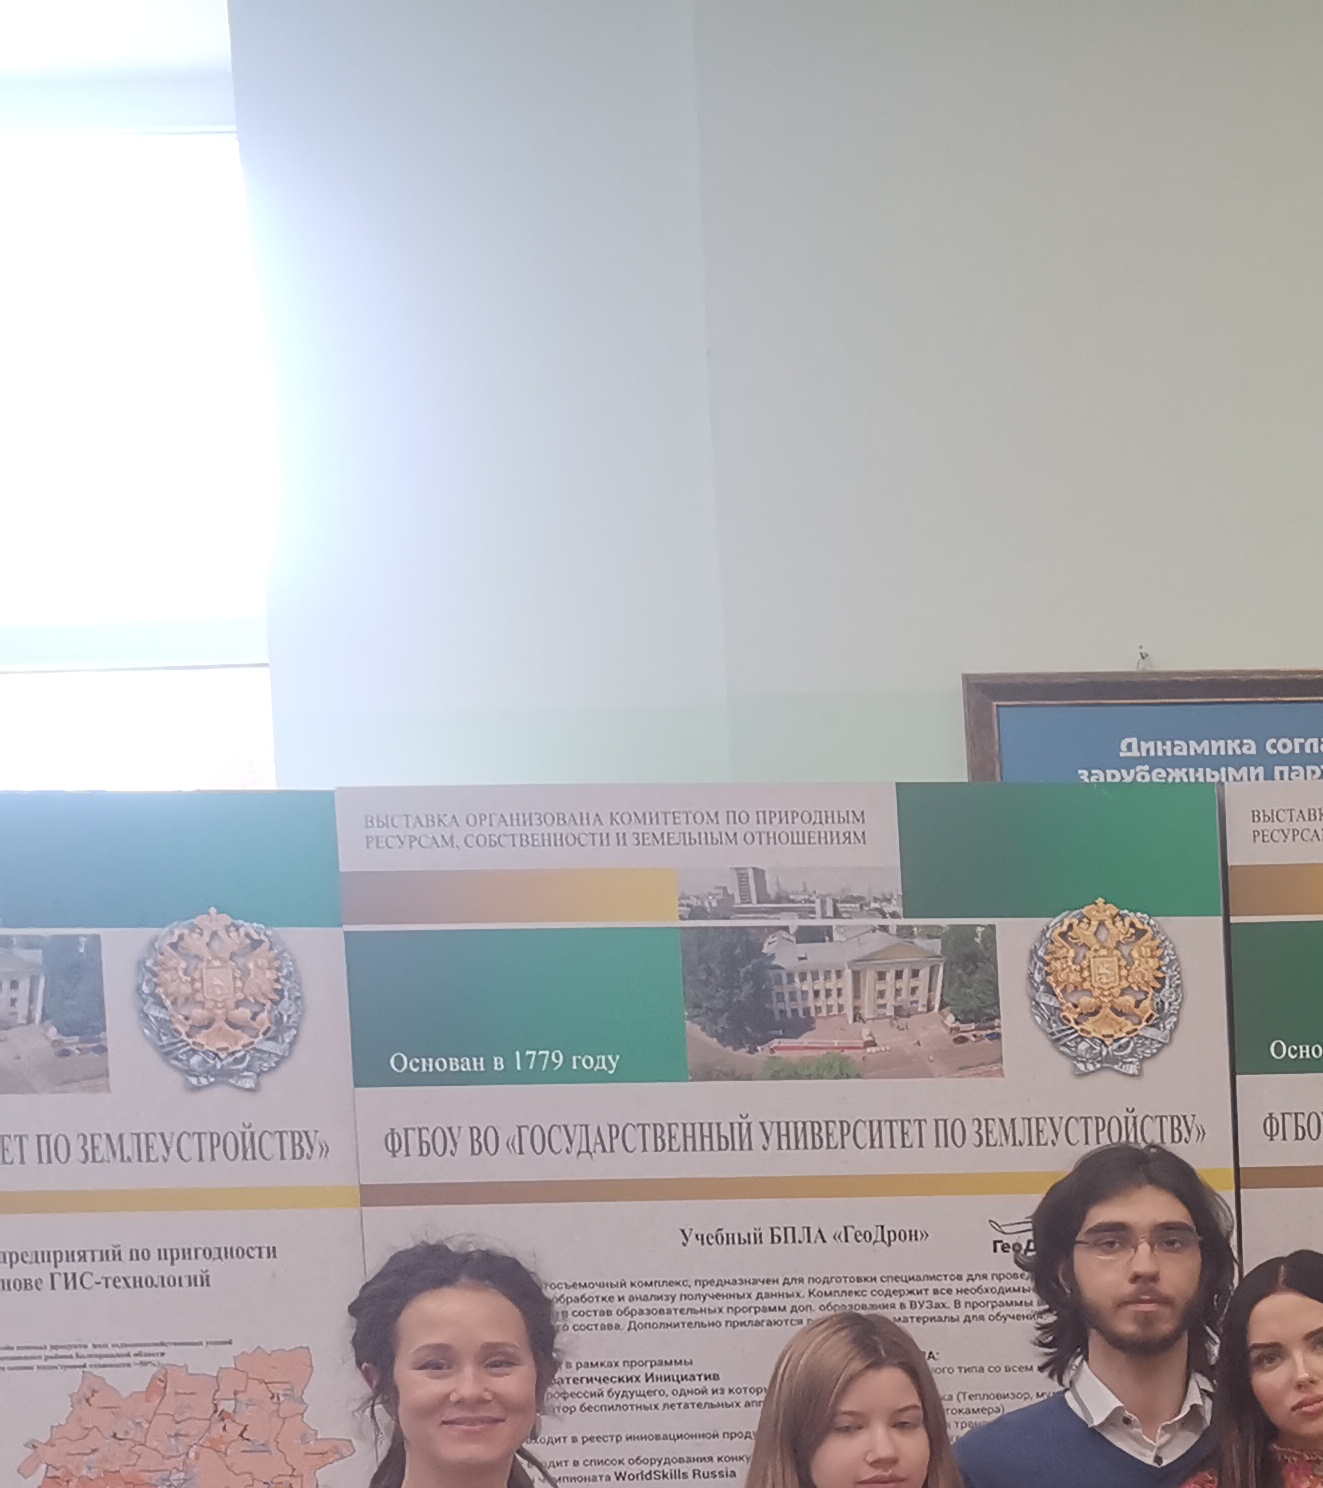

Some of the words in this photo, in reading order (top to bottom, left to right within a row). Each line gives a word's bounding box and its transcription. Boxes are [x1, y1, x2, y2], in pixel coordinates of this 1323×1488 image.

[1120, 736, 1256, 757] Динамика
[1078, 764, 1263, 783] зарубежными
[365, 814, 460, 829] ВЫСТАВКА
[465, 813, 602, 829] ОРГАНИЗОВАНА
[610, 810, 720, 827] КОМИТЕТОМ
[726, 810, 750, 825] ПО
[756, 809, 865, 827] ПРИРОДНЫМ
[366, 834, 460, 851] РЕСУРСАМ,
[465, 832, 610, 849] СОБСТВЕННОСТИ
[615, 832, 626, 846] И
[632, 831, 737, 847] ЗЕМЕЛЬНЫМ
[743, 830, 866, 846] ОТНОШЕНИЯМ
[390, 1051, 486, 1074] Основан
[493, 1056, 505, 1070] в
[514, 1048, 563, 1072] 1779
[571, 1053, 620, 1075] году
[385, 1124, 464, 1159] ФГБОУ
[471, 1125, 499, 1156] ВО
[507, 1114, 752, 1156] «ГОСУДАРСТВЕННЫЙ
[760, 1118, 926, 1151] УНИВЕРСИТЕТ
[936, 1117, 966, 1148] ПО
[974, 1108, 1205, 1149] ЗЕМЛЕУСТРОЙСТВУ»
[37, 1134, 70, 1165] ПО
[77, 1122, 330, 1163] ЗЕМЛЕУСТРОЙСТВУ»
[679, 1225, 764, 1249] Учебный
[770, 1226, 827, 1246] БПЛА
[833, 1225, 929, 1247] «ГеоДрон»
[129, 1247, 151, 1262] по
[157, 1246, 278, 1268] пригодности
[50, 1270, 211, 1290] ГИС-технологий
[694, 1277, 779, 1289] предназначен
[783, 1276, 804, 1286] для
[808, 1274, 877, 1285] подготовки
[880, 1272, 963, 1284] специалистов
[966, 1272, 988, 1281] для
[628, 1294, 676, 1305] анализу
[680, 1291, 753, 1302] полученных
[808, 1288, 867, 1298] Комплекс
[870, 1286, 928, 1298] содержит
[933, 1287, 952, 1295] все
[572, 1308, 612, 1317] состав
[616, 1304, 724, 1317] образовательных
[726, 1304, 788, 1315] программ
[627, 1319, 722, 1331] Дополнительно
[576, 1360, 619, 1369] рамках
[623, 1358, 693, 1369] программы
[645, 1372, 720, 1383] Инициатив
[672, 1386, 708, 1397] одной
[580, 1401, 659, 1413] беспилотных
[662, 1400, 741, 1410] летательных
[581, 1434, 622, 1444] реестр
[626, 1430, 719, 1442] инновационной
[583, 1458, 624, 1468] список
[628, 1454, 713, 1465] оборудования
[614, 1470, 688, 1482] WorldSkills
[692, 1468, 736, 1479] Russia
